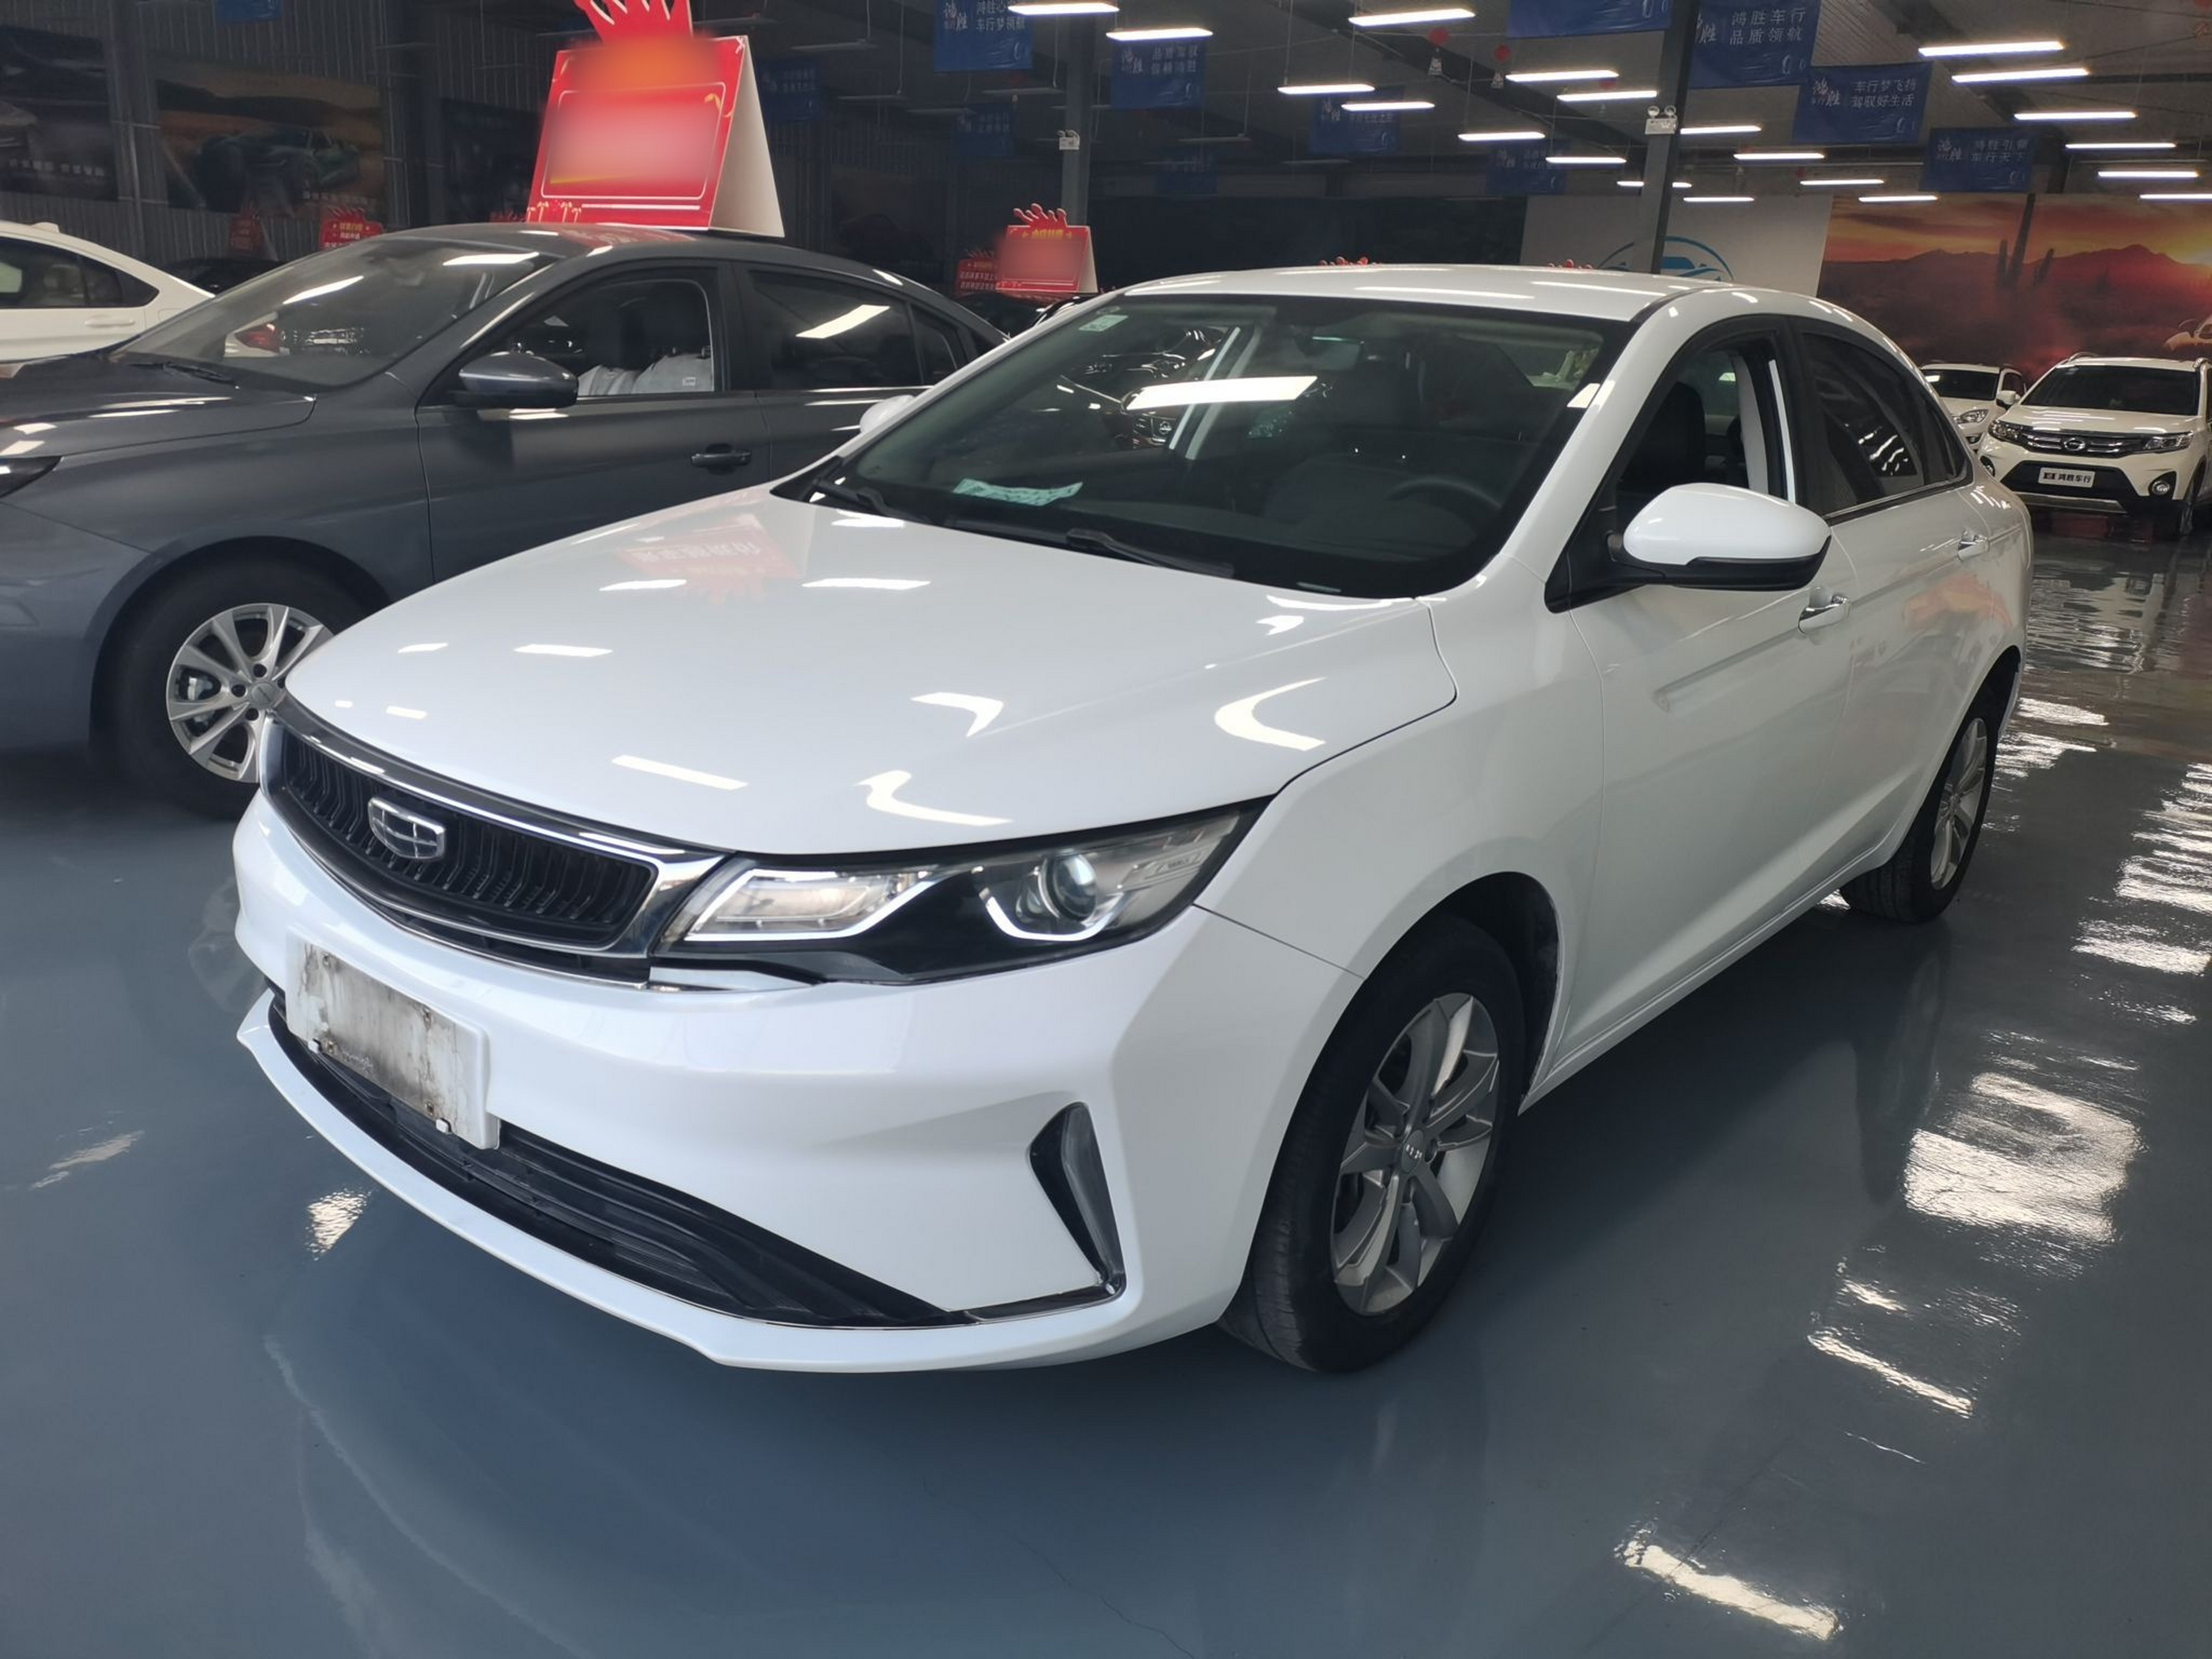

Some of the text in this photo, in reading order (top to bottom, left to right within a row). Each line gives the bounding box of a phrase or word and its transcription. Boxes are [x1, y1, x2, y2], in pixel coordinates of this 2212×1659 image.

[1732, 7, 1806, 26] 鸿胜车行
[1729, 26, 1802, 46] 品质领航
[1850, 93, 1915, 108] 驾驭好生活
[1971, 152, 2026, 164] 车行天下
